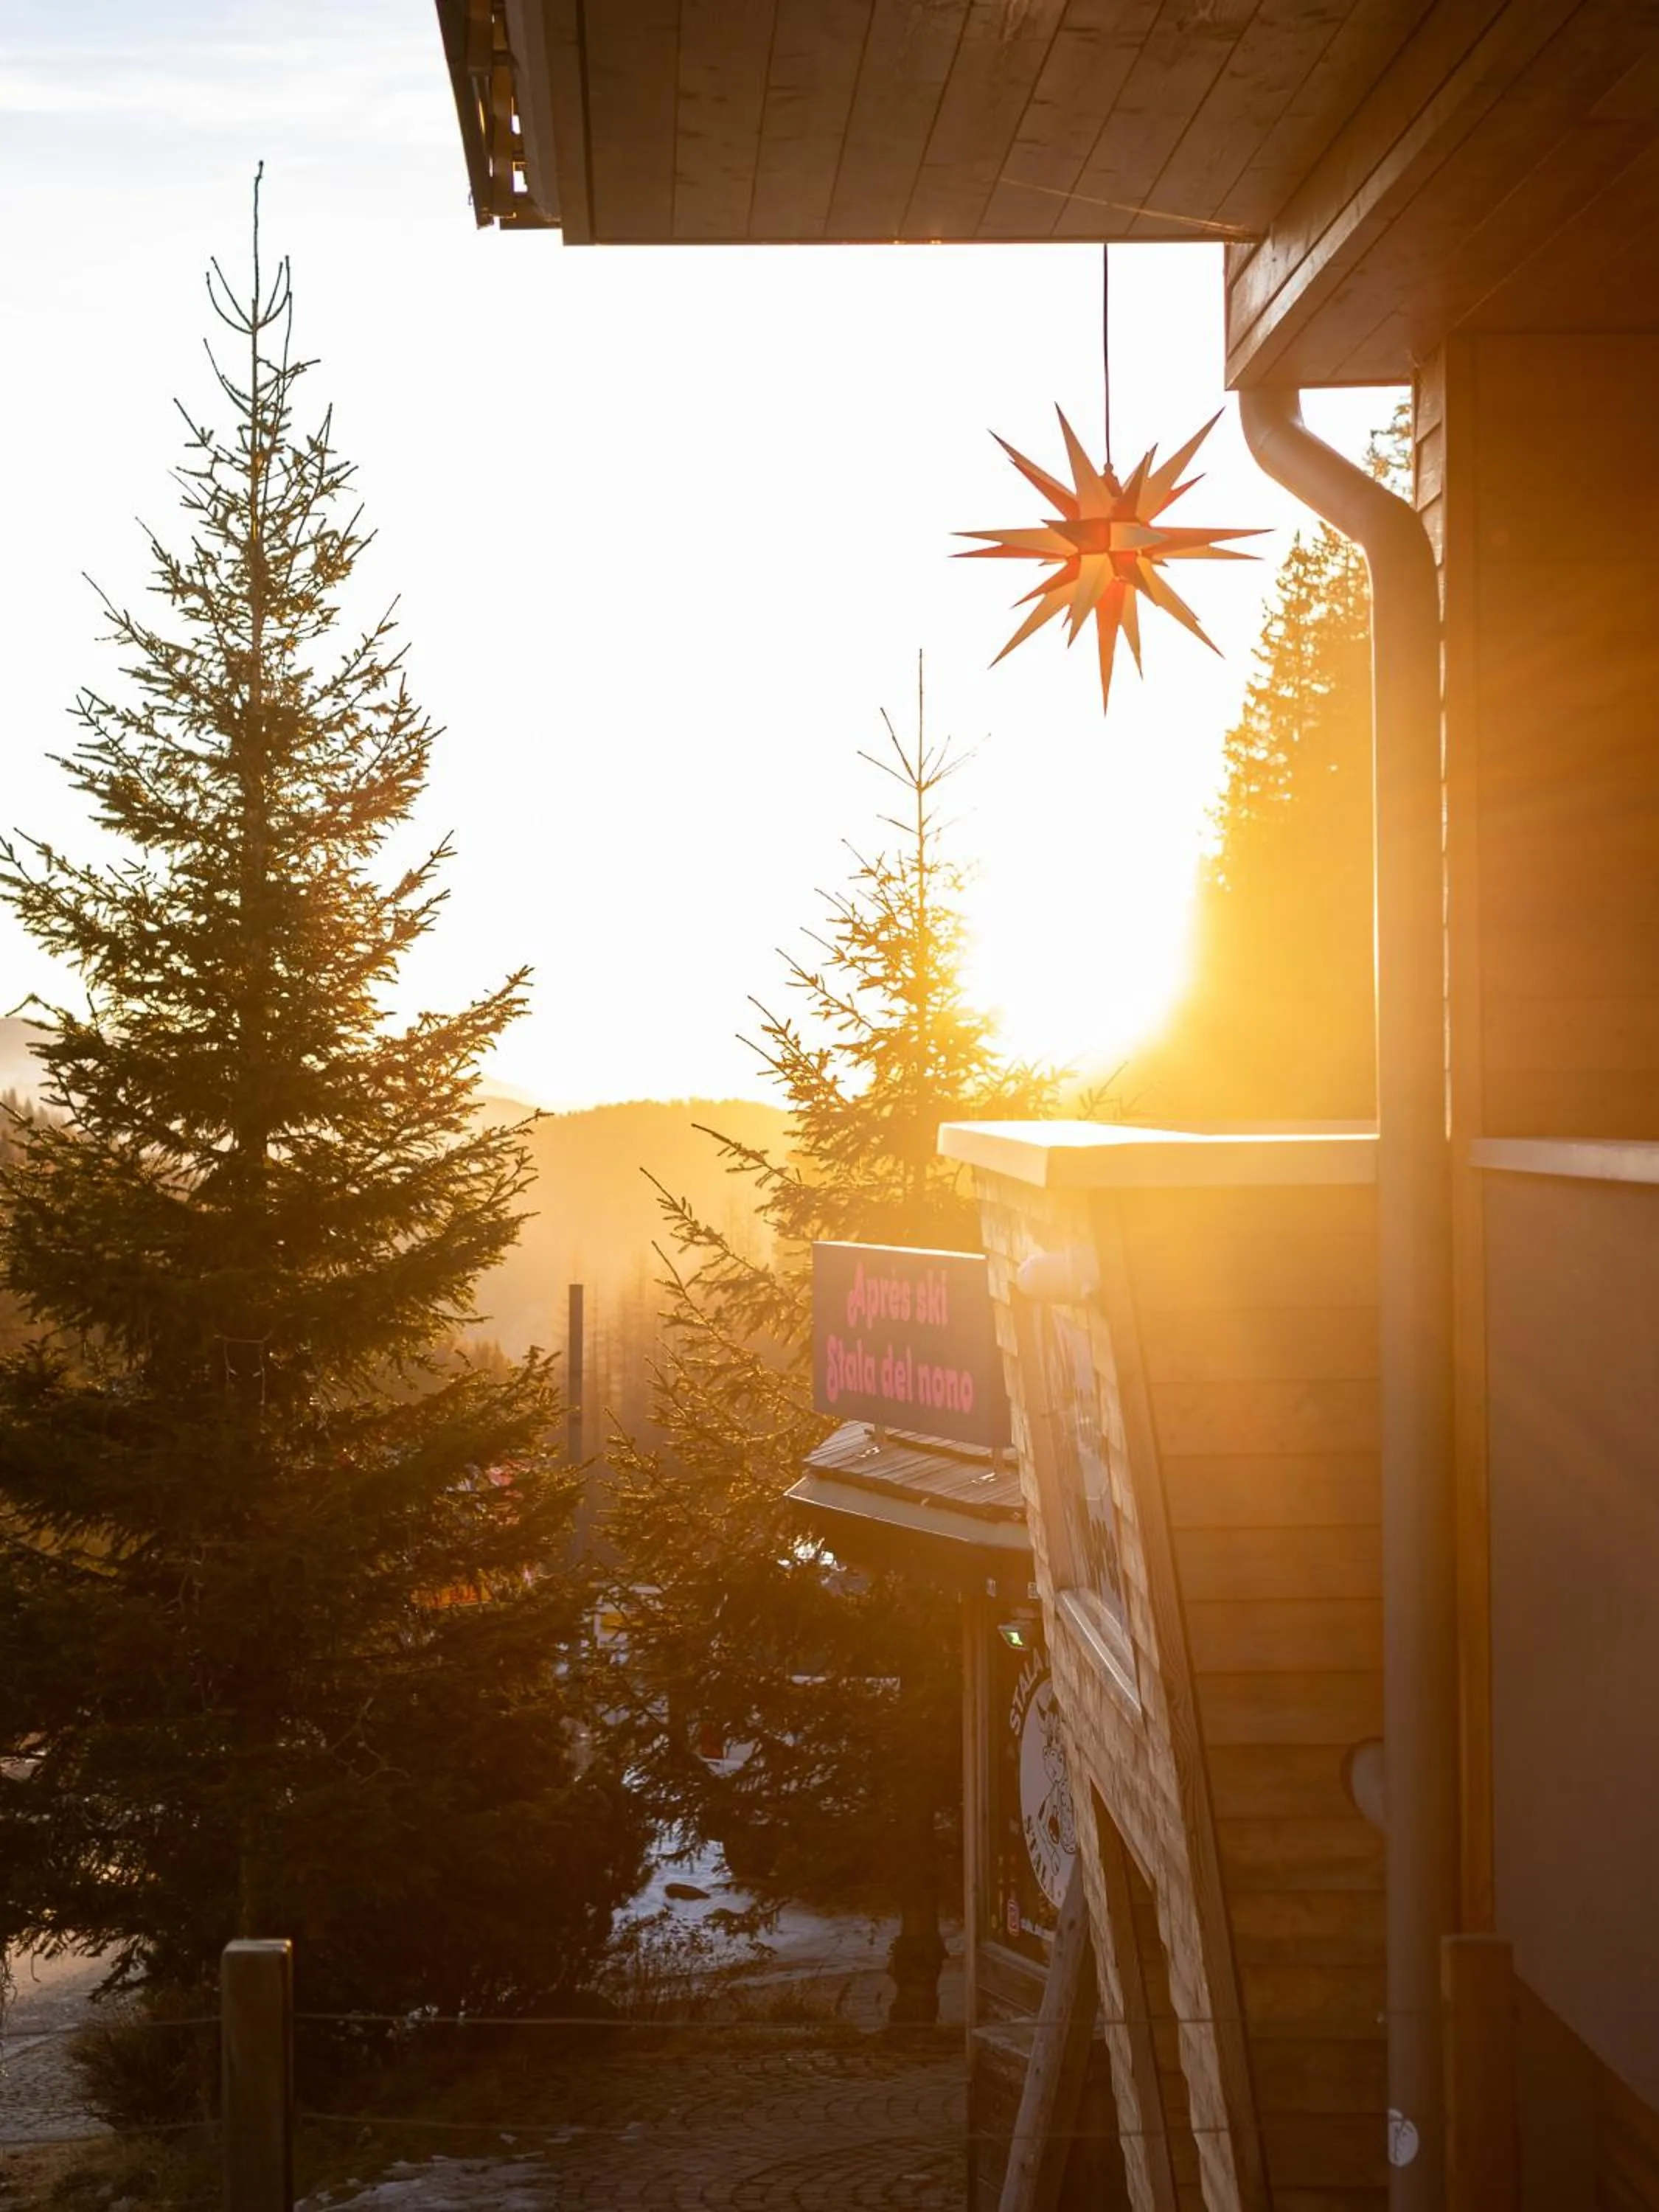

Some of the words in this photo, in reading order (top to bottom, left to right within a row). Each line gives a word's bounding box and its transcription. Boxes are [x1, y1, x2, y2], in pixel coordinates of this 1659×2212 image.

[917, 1269, 948, 1326] ski
[882, 1343, 913, 1402] del
[918, 1364, 973, 1415] nono
[1009, 1647, 1043, 1736] STALA
